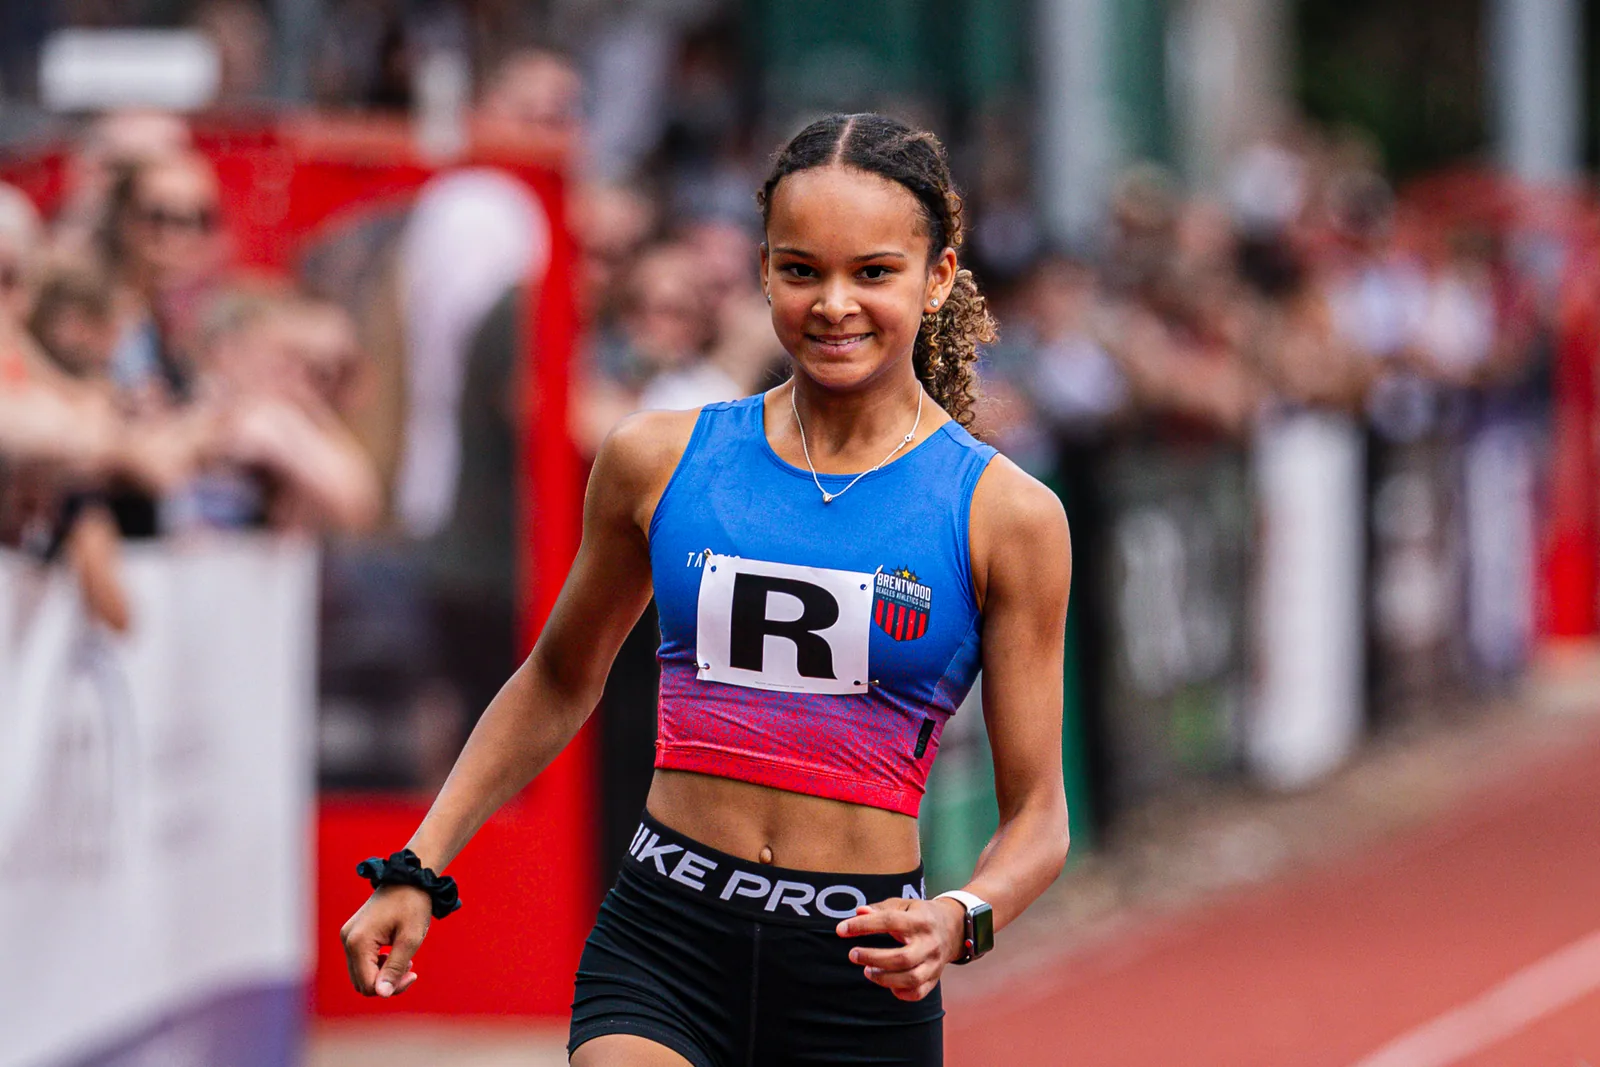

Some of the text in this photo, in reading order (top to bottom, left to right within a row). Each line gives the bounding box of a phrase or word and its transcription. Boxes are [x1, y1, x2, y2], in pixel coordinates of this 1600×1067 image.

[875, 585, 896, 598] BEAGLES
[896, 592, 919, 606] ATHLETICS
[919, 598, 931, 610] CLUB
[876, 572, 931, 602] BRENTWOOD
[729, 572, 839, 680] R
[719, 870, 867, 919] PRO
